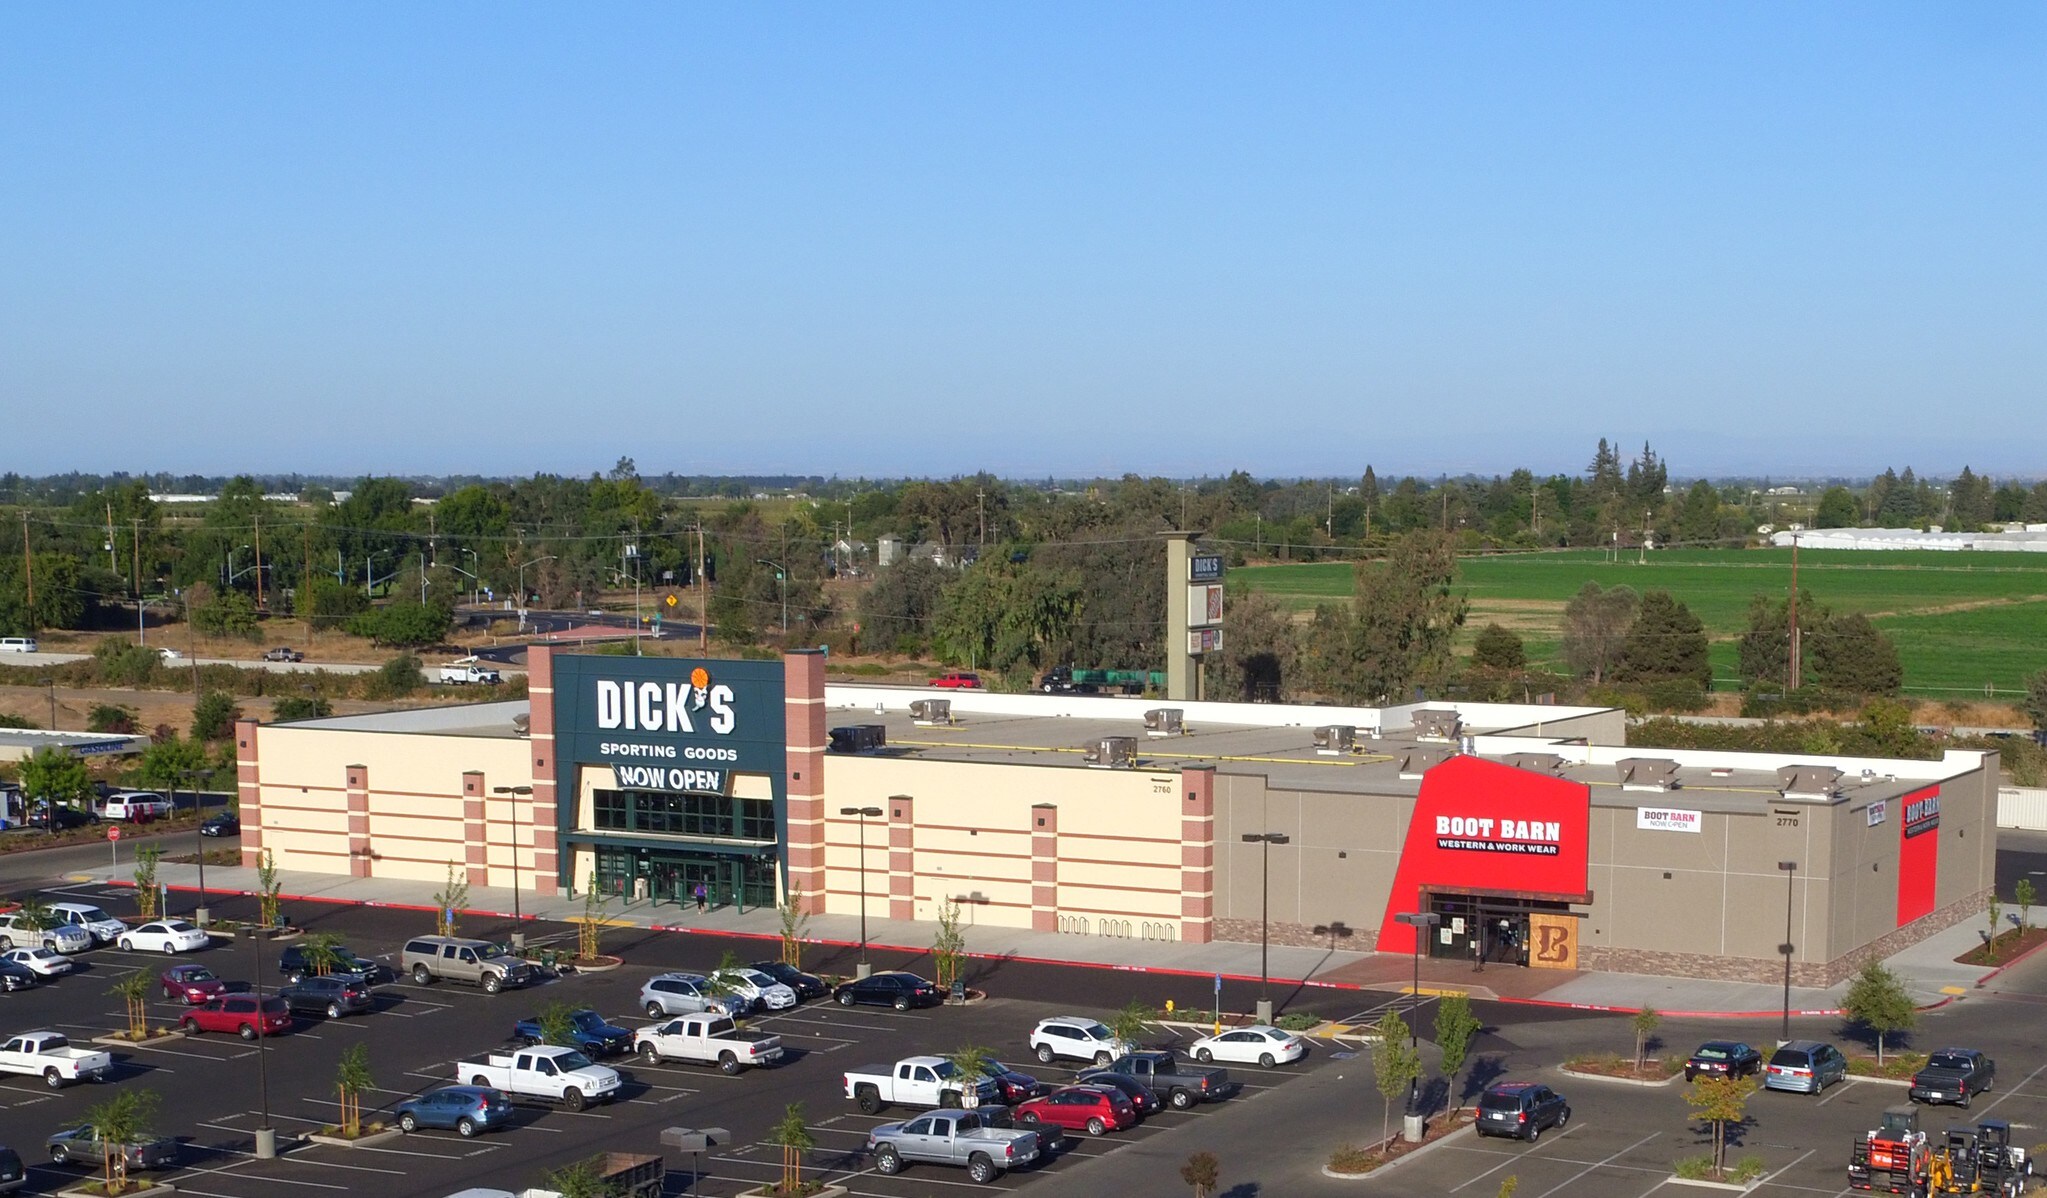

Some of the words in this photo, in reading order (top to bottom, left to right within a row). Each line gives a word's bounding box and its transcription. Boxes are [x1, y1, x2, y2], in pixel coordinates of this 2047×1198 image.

[597, 680, 735, 734] DICK'S
[600, 743, 676, 758] SPORTING
[684, 747, 737, 761] GOODS
[620, 766, 665, 788] NOW
[669, 769, 719, 790] OPEN
[1153, 785, 1171, 793] 2760
[1644, 811, 1669, 821] BOOT
[1670, 812, 1695, 823] BARN
[1650, 820, 1667, 828] NOW
[1777, 818, 1799, 827] 2770
[1436, 815, 1493, 837] BOOT
[1500, 819, 1560, 841] BARN
[1439, 839, 1486, 850] WESTERN
[1487, 841, 1495, 850] &
[1496, 842, 1525, 852] WORK
[1527, 844, 1557, 854] WEAR
